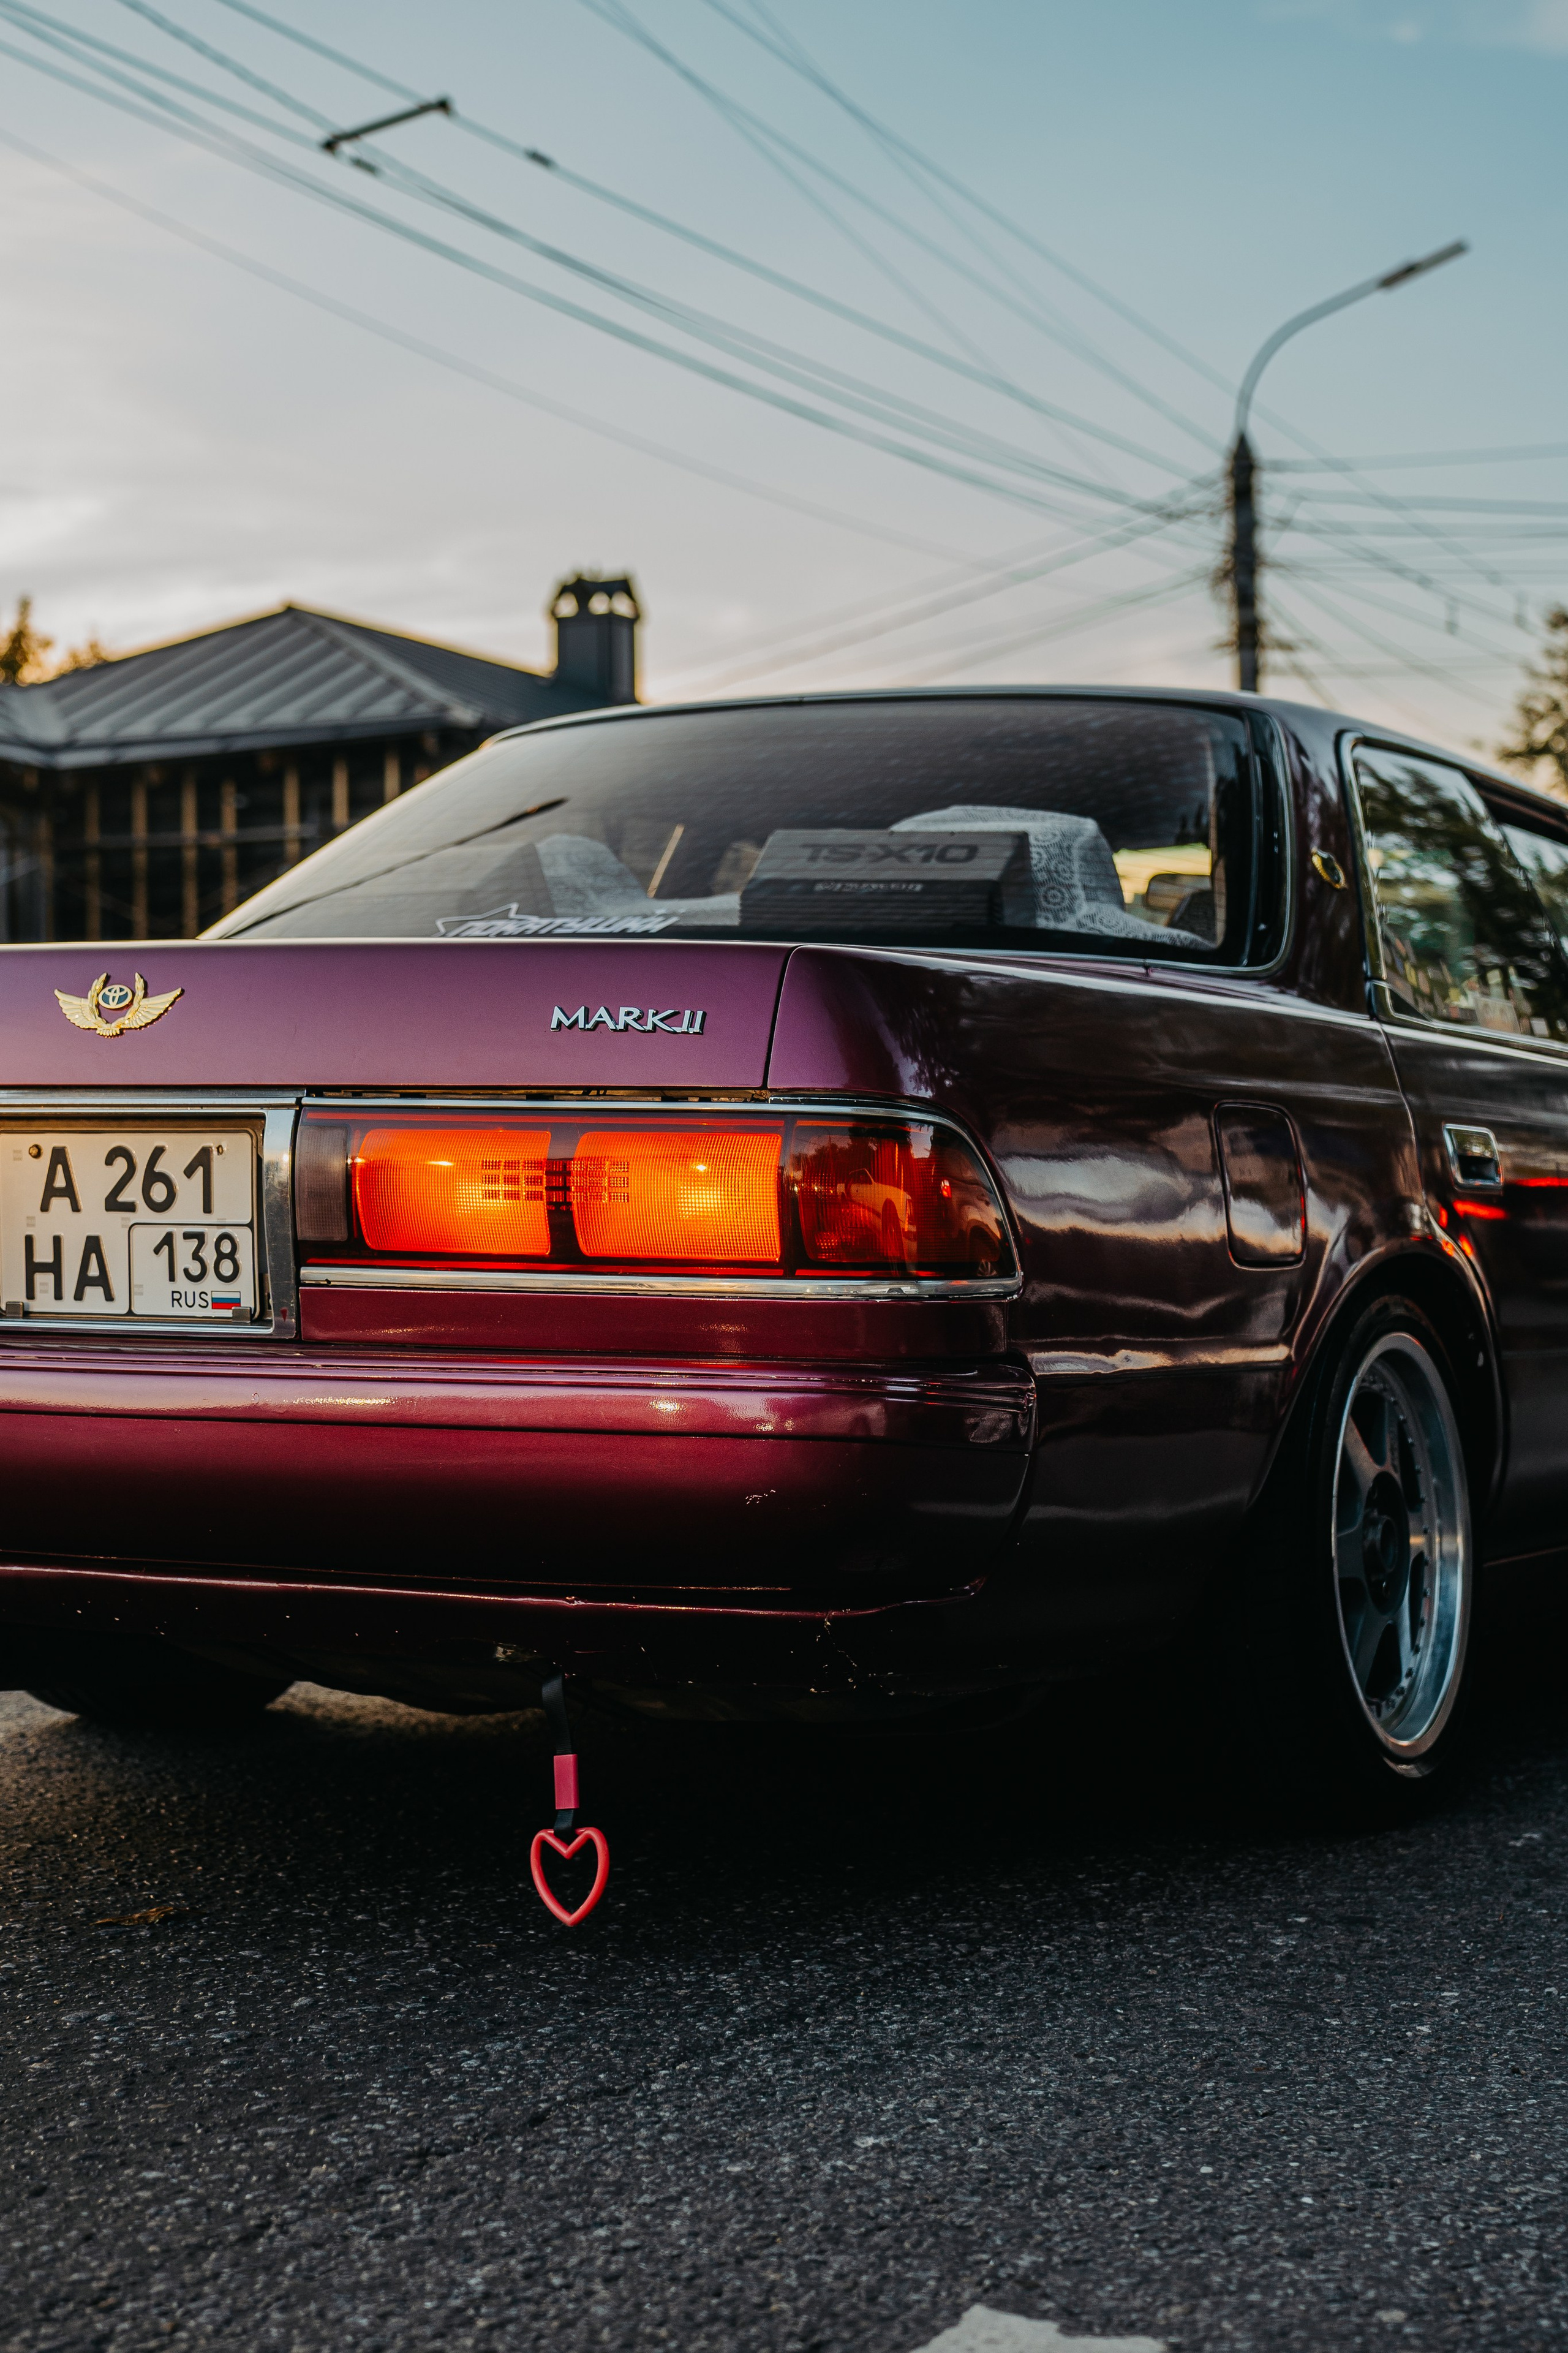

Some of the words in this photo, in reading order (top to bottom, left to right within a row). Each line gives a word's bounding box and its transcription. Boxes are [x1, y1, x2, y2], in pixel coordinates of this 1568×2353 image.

[40, 1146, 83, 1213] A
[104, 1145, 214, 1215] 261
[153, 1231, 241, 1283] 138
[171, 1290, 209, 1309] RUS
